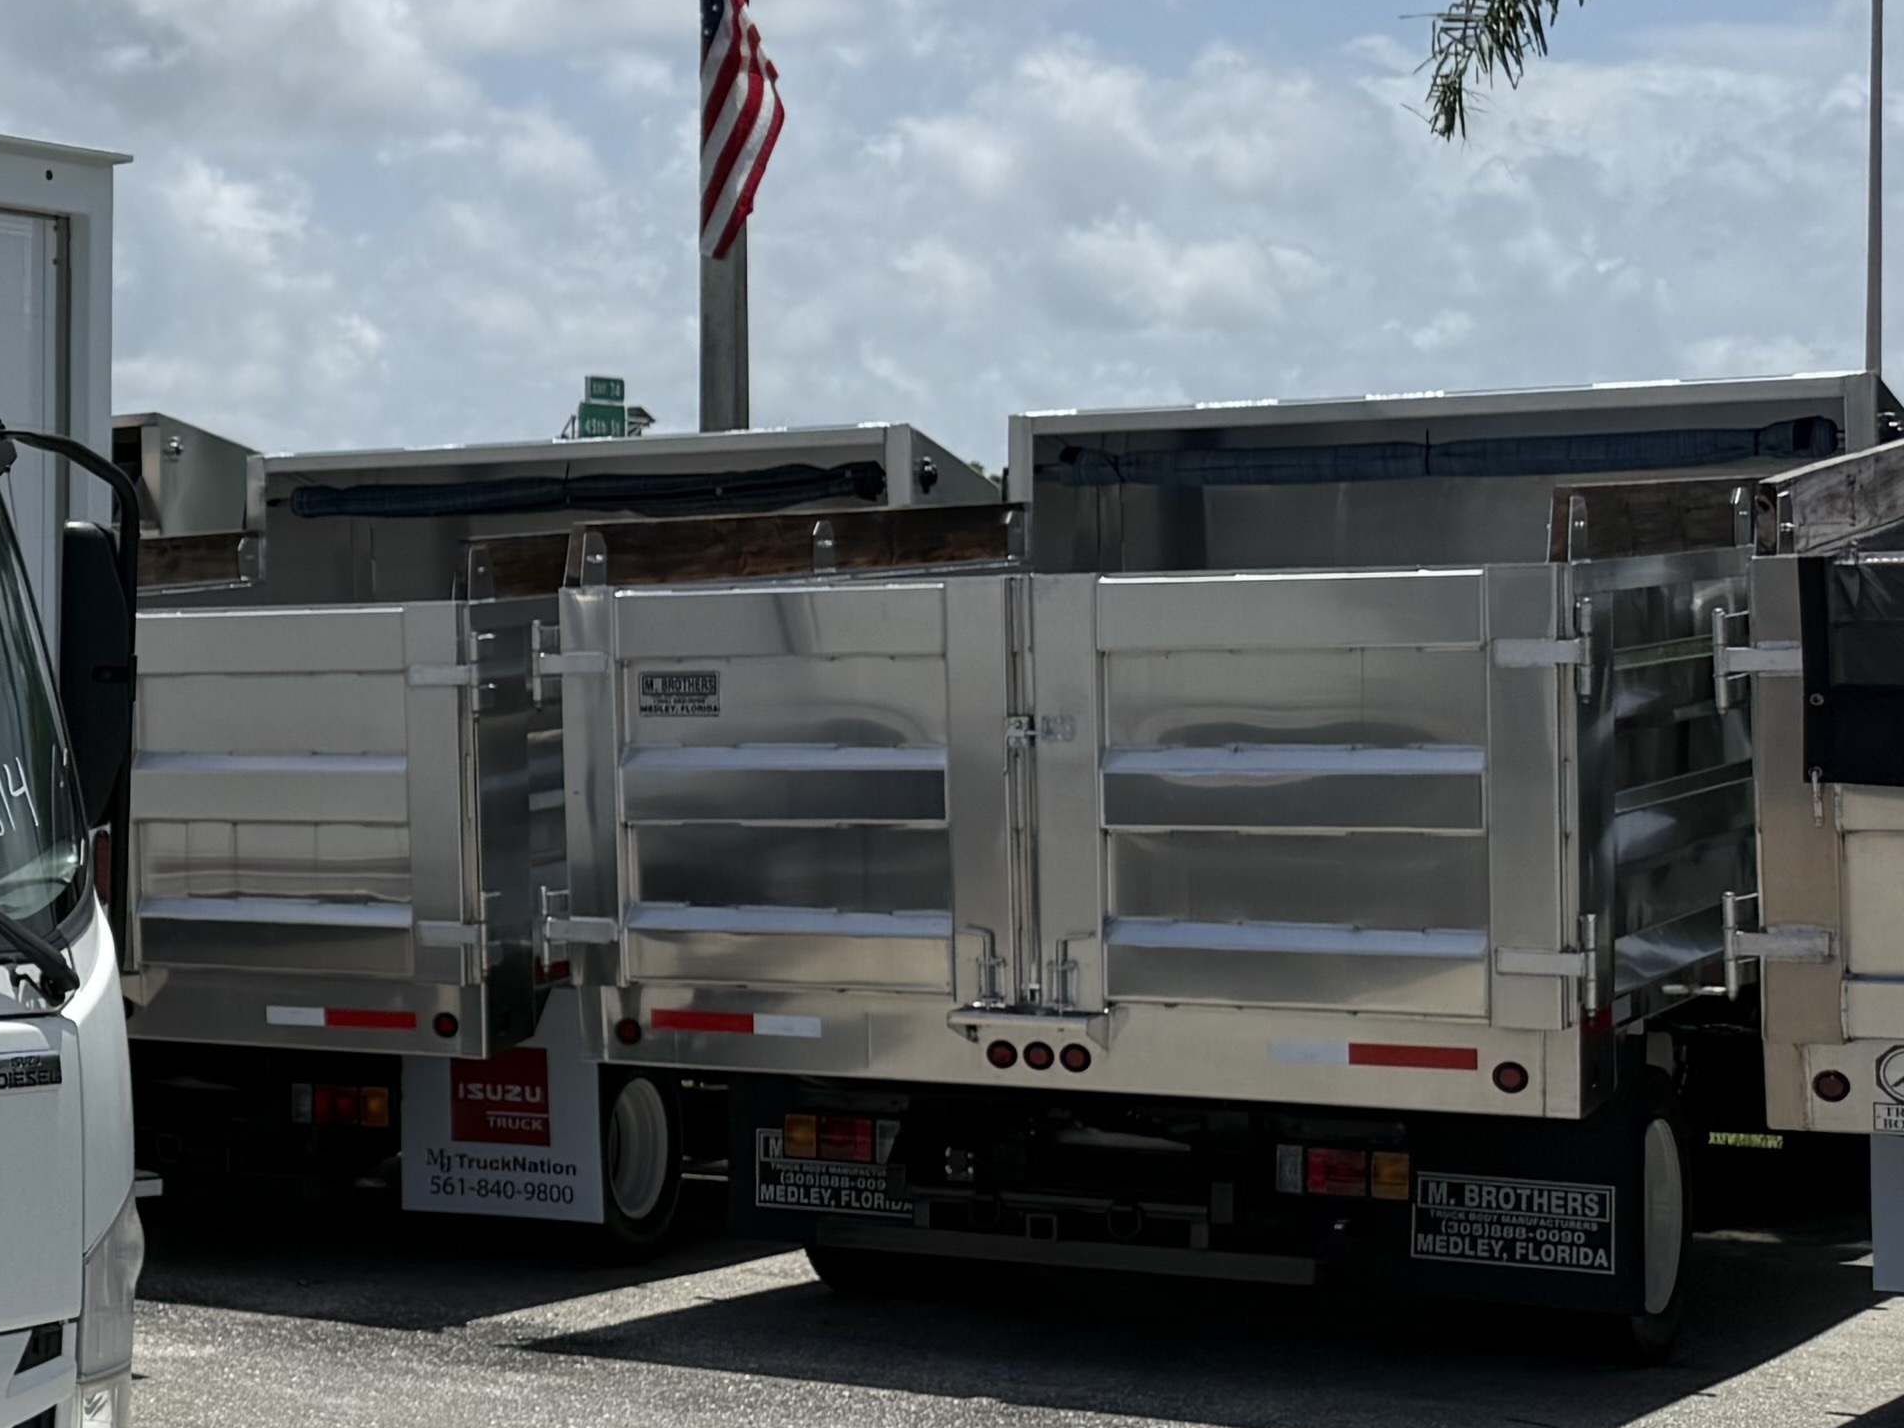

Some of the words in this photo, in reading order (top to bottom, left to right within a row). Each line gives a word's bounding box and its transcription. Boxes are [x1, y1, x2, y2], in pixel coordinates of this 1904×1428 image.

[661, 677, 716, 691] BROTHERS
[458, 1082, 542, 1103] ISUZU
[486, 1115, 543, 1131] TRUCK
[455, 1152, 578, 1177] TruckNation
[429, 1175, 575, 1205] 561-840-9800
[760, 1183, 836, 1208] MEDLEY,
[1427, 1181, 1456, 1207] M.
[1464, 1184, 1600, 1217] BROTHERS
[1430, 1208, 1466, 1221] TRUCK
[1468, 1211, 1498, 1223] BODY
[1501, 1214, 1599, 1232] MANUFACTURERS
[1416, 1232, 1508, 1262] MEDLEY,
[1515, 1241, 1609, 1269] FLORIDA
